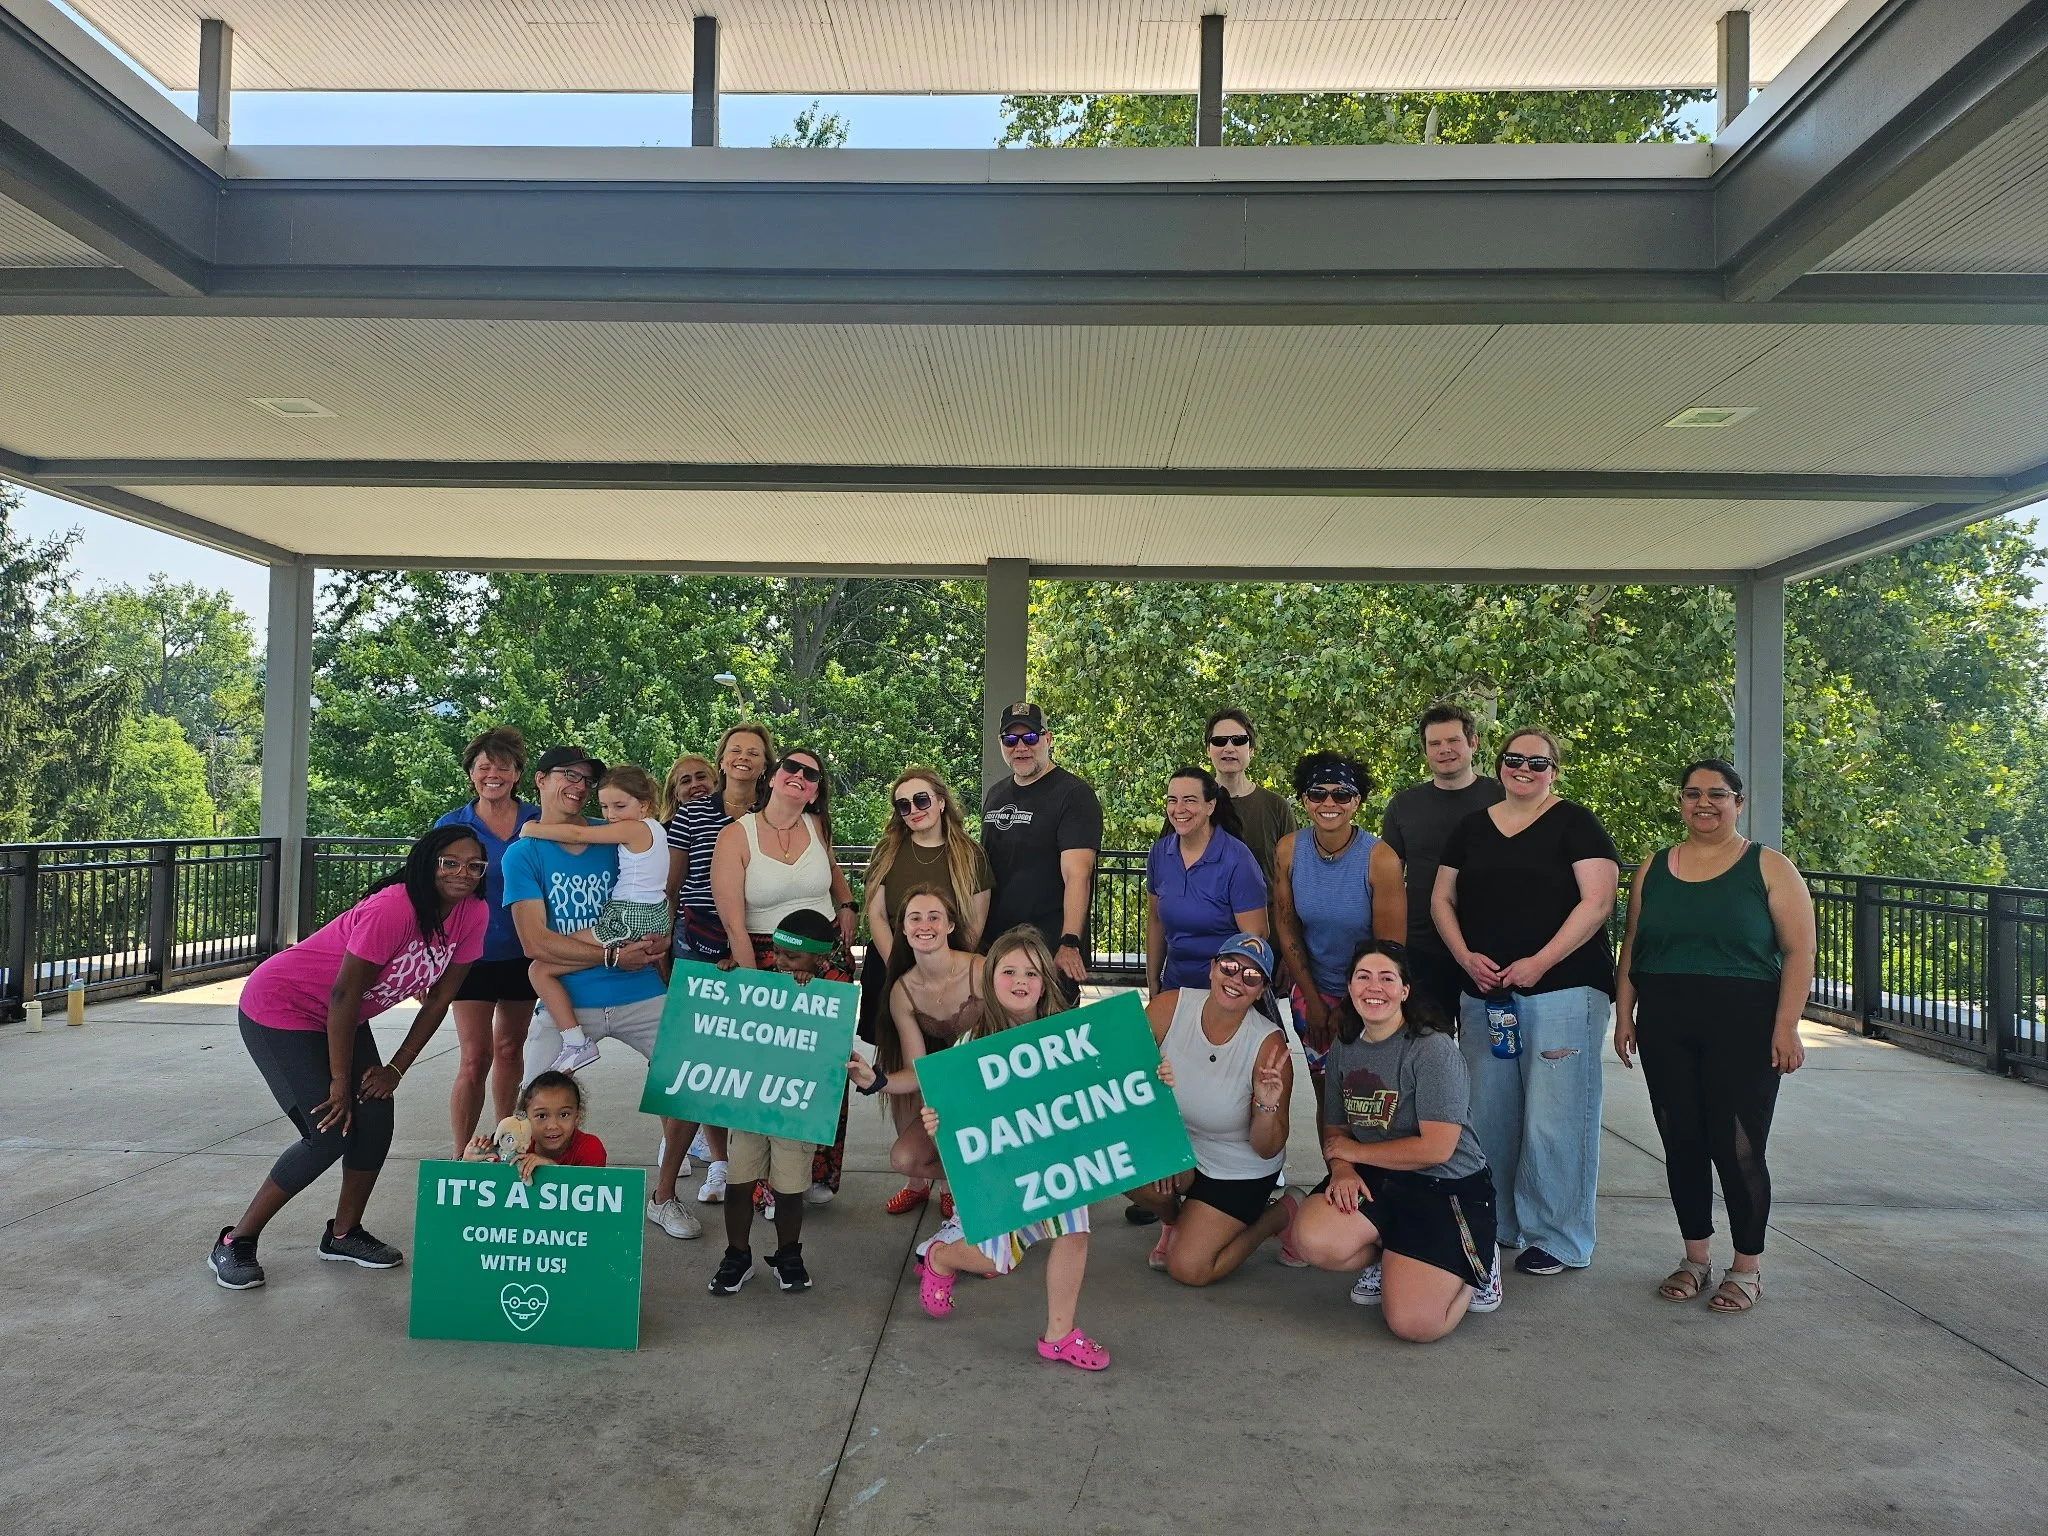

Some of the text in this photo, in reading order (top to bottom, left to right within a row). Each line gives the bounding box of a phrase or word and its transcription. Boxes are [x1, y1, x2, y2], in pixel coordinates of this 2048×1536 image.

[687, 977, 841, 1019] YES, YOU ARE
[694, 1013, 818, 1053] WELCOME!
[977, 1023, 1100, 1090] DORK
[664, 1060, 817, 1110] JOIN US!
[955, 1070, 1156, 1164] DANCING
[436, 1178, 623, 1213] IT'S A SIGN
[1014, 1141, 1136, 1212] ZONE
[462, 1226, 588, 1247] COME DANCE
[480, 1255, 567, 1274] WITH US!
